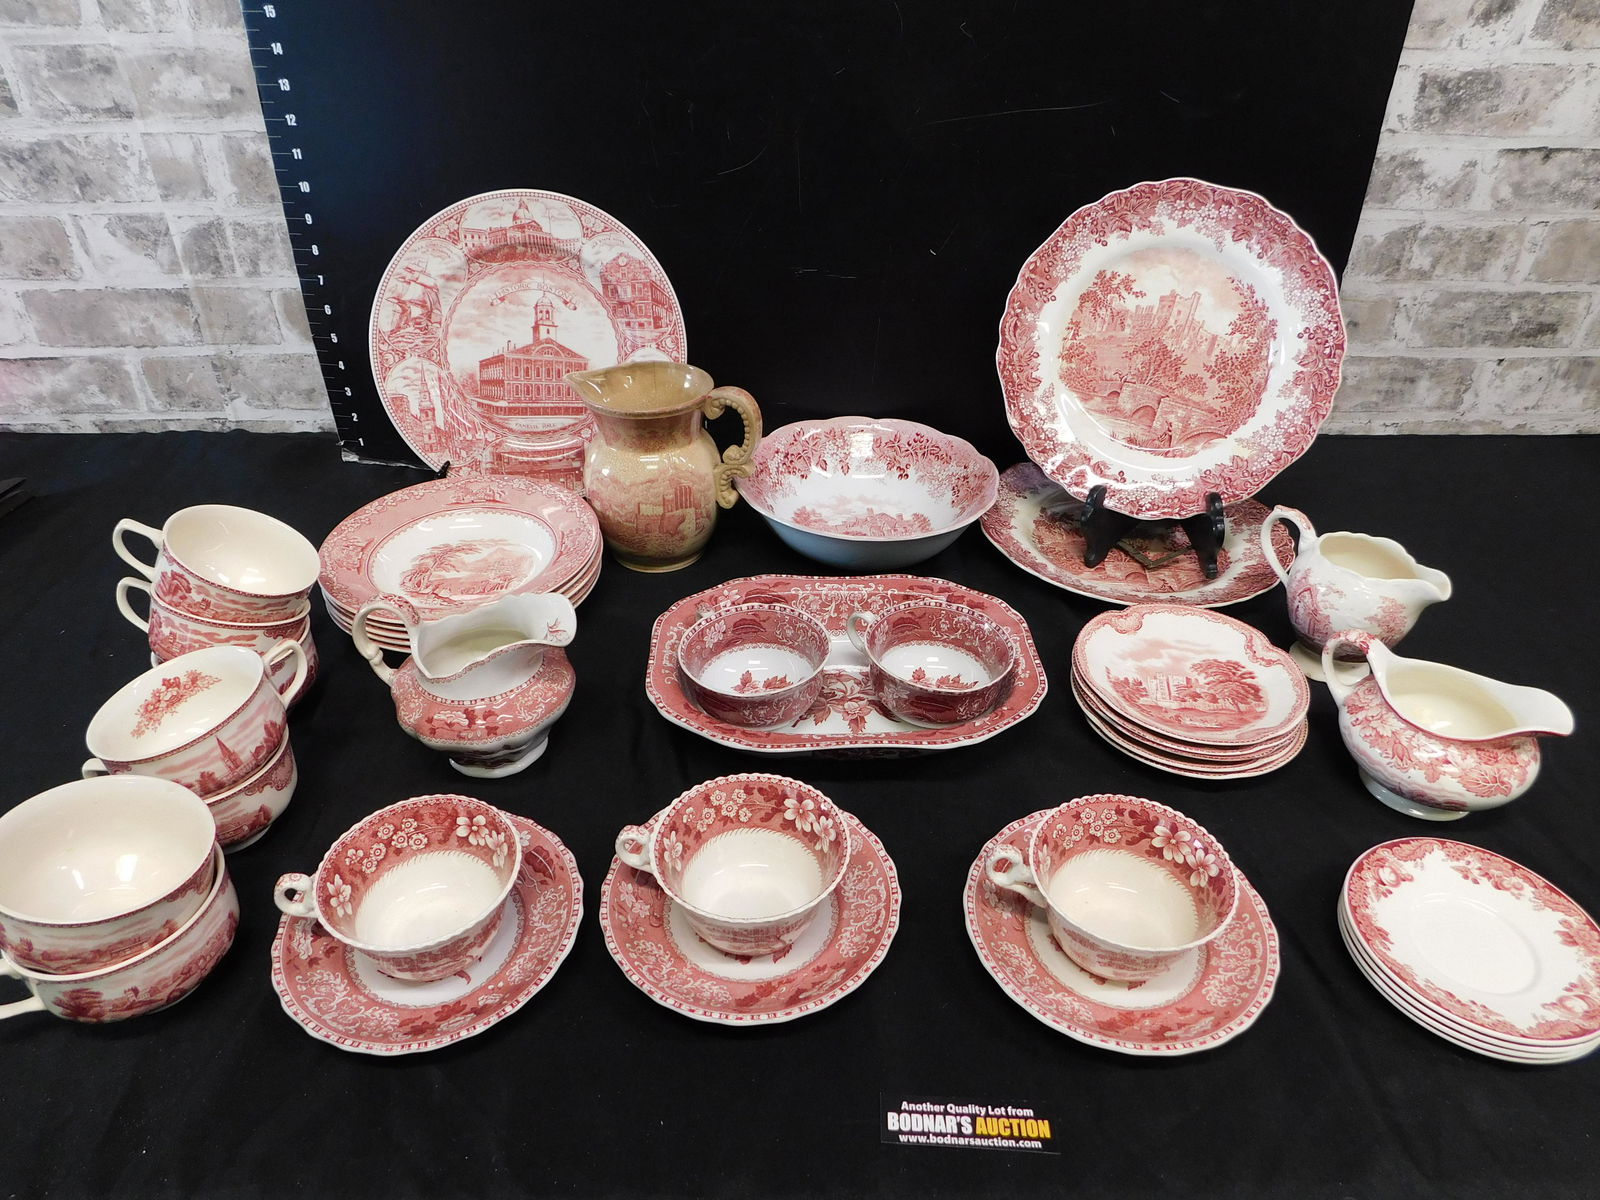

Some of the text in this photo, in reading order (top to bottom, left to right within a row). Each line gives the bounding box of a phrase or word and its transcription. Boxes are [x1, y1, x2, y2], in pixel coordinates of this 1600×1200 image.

[264, 5, 276, 18] 15
[271, 42, 283, 55] 14
[278, 79, 290, 91] 13
[285, 114, 297, 126] 12
[292, 148, 302, 160] 11
[298, 181, 310, 193] 10
[305, 213, 313, 225] 9
[311, 245, 319, 256] 8
[317, 275, 324, 285] 7
[324, 305, 331, 315] 6
[330, 333, 338, 344] 5
[338, 361, 345, 370] 4
[344, 387, 352, 396] 3
[351, 413, 358, 422] 2
[358, 437, 364, 447] 1
[901, 1101, 1034, 1117] Another Quality Lot from
[887, 1111, 1052, 1139] BODNAR'S AUCTION
[898, 1134, 1043, 1149] www.bodnarsauction.com
